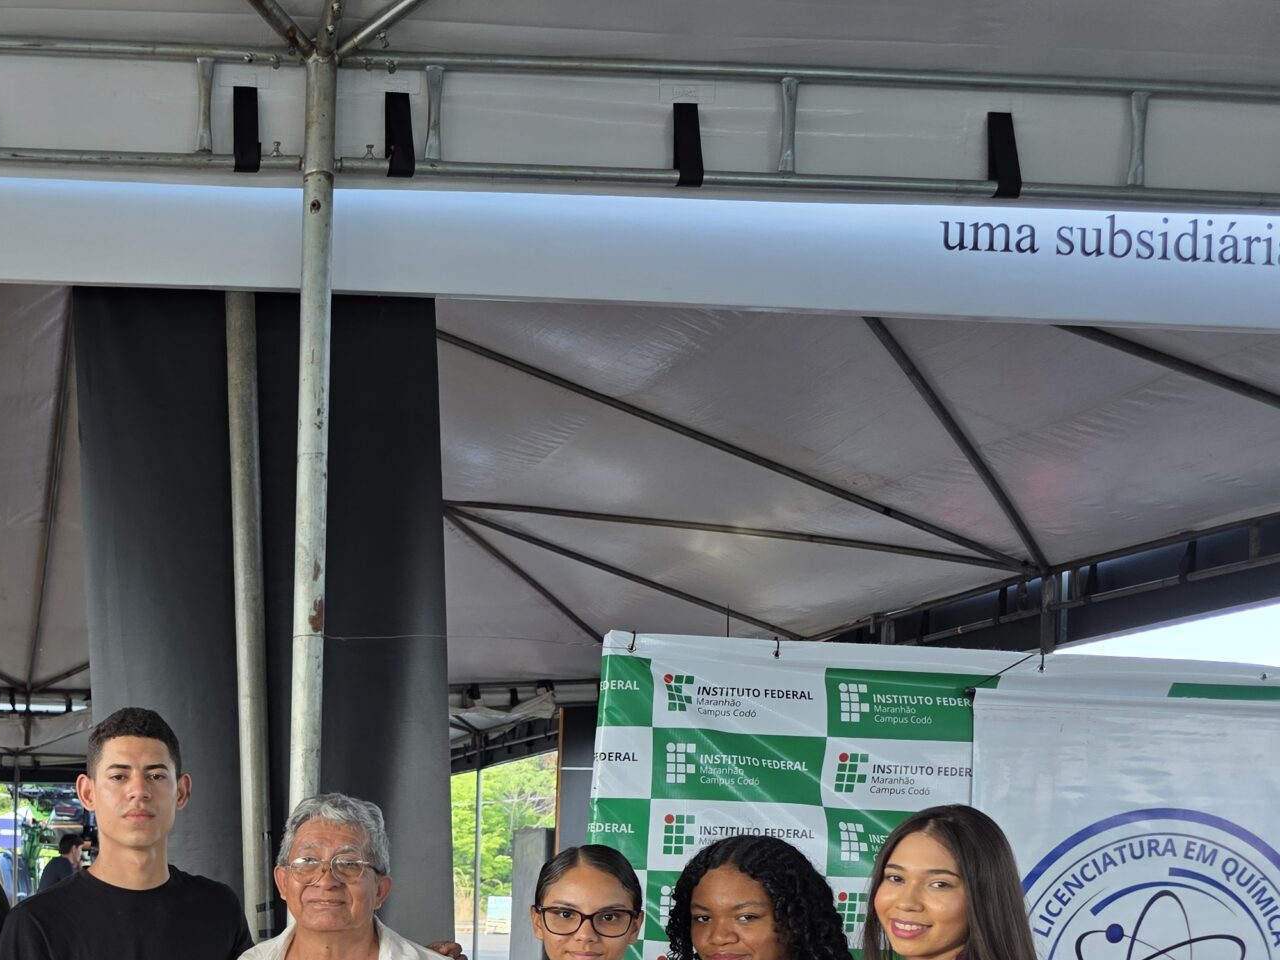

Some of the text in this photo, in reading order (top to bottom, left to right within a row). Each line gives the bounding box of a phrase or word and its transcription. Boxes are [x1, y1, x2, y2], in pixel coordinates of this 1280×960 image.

[939, 214, 1280, 266] uma subsidiári
[697, 686, 814, 700] INSTITUTO FEDERAL
[696, 698, 742, 708] Maranhão
[873, 694, 933, 705] INSTITUTO
[697, 707, 757, 718] Campus Codó
[873, 705, 916, 714] Maranhão
[874, 714, 932, 725] Campus Codó
[700, 754, 808, 771] INSTITUTO FEDERAL
[699, 766, 744, 775] Maranhão
[872, 764, 934, 776] INSTITUTO
[700, 776, 760, 786] Campus Codó
[871, 776, 915, 785] Maranhão
[870, 786, 930, 796] Campus Codó
[699, 826, 814, 839] INSTITUTO FEDERAL
[1033, 838, 1177, 938] LICENCIATURA
[1183, 840, 1218, 866] EM
